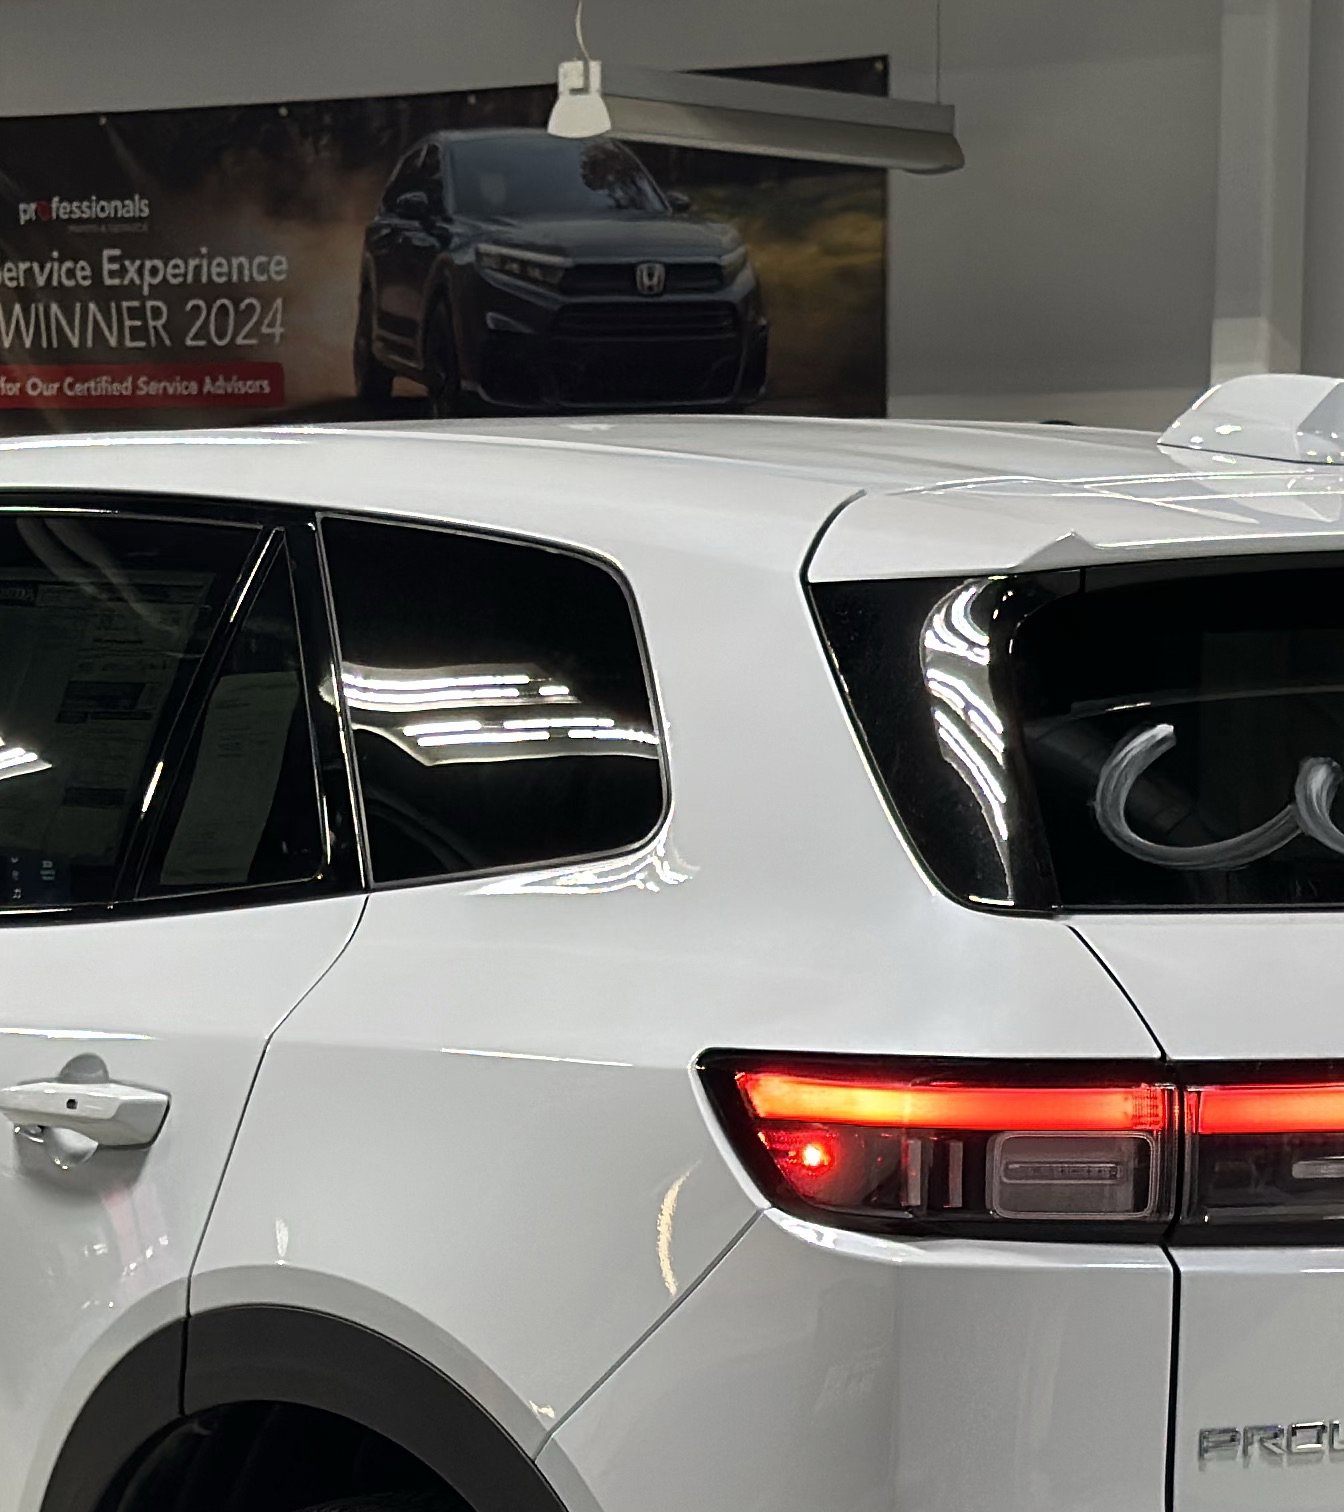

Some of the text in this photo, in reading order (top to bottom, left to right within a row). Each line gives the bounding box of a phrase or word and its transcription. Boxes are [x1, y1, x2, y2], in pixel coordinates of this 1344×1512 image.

[102, 247, 289, 296] Experience
[184, 297, 285, 348] 2024
[0, 376, 21, 396] for
[26, 377, 60, 396] Our
[63, 376, 132, 397] Certified
[136, 376, 198, 396] Service
[203, 374, 270, 396] Advisors
